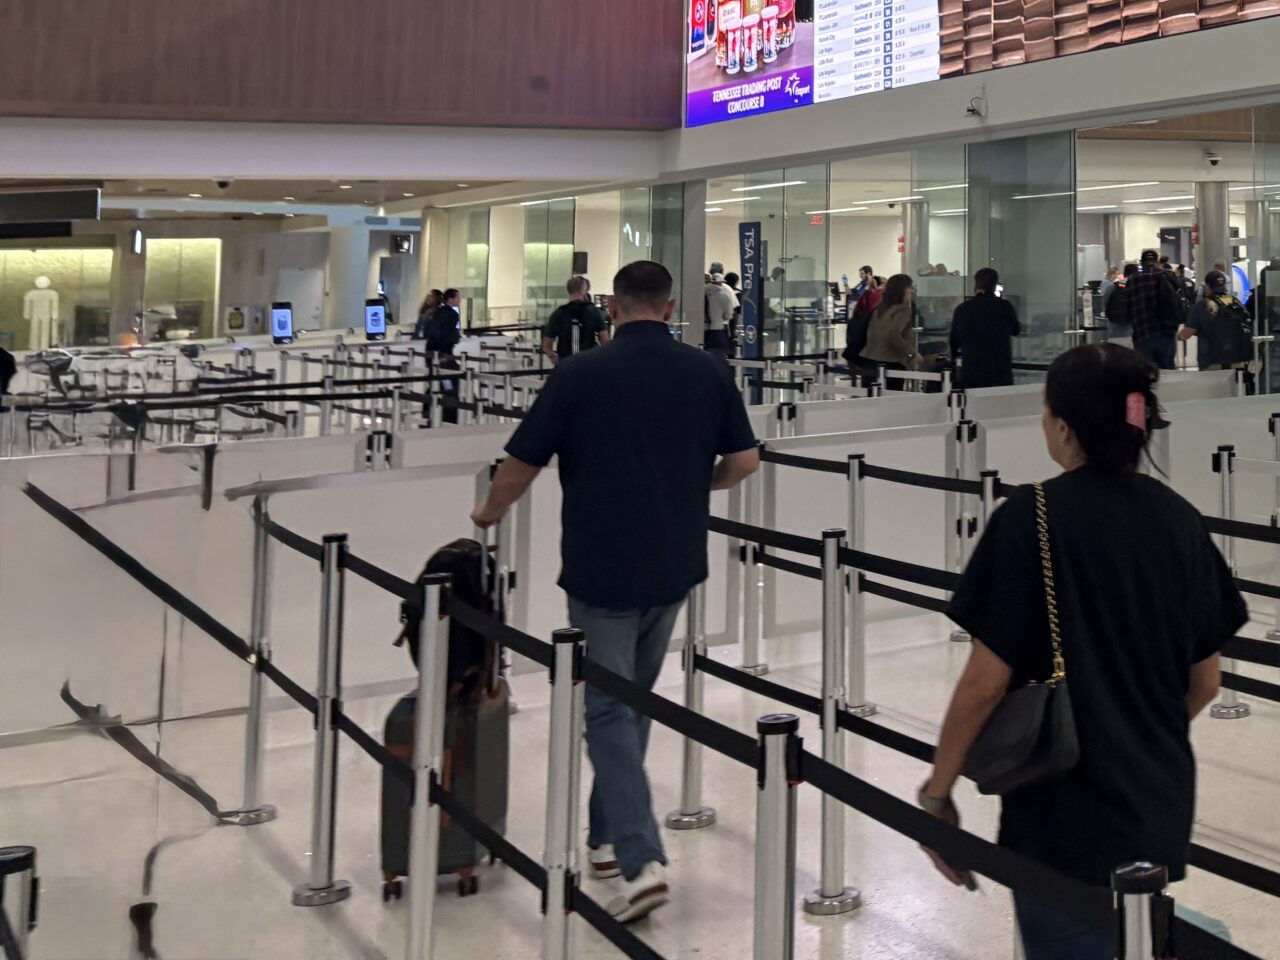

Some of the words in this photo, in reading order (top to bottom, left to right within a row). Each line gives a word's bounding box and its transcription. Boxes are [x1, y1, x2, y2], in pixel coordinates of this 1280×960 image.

[742, 79, 767, 97] TRADING
[766, 76, 782, 92] POST
[728, 96, 760, 114] CONCOURSE
[744, 228, 755, 259] TSA
[743, 263, 755, 289] Pre
